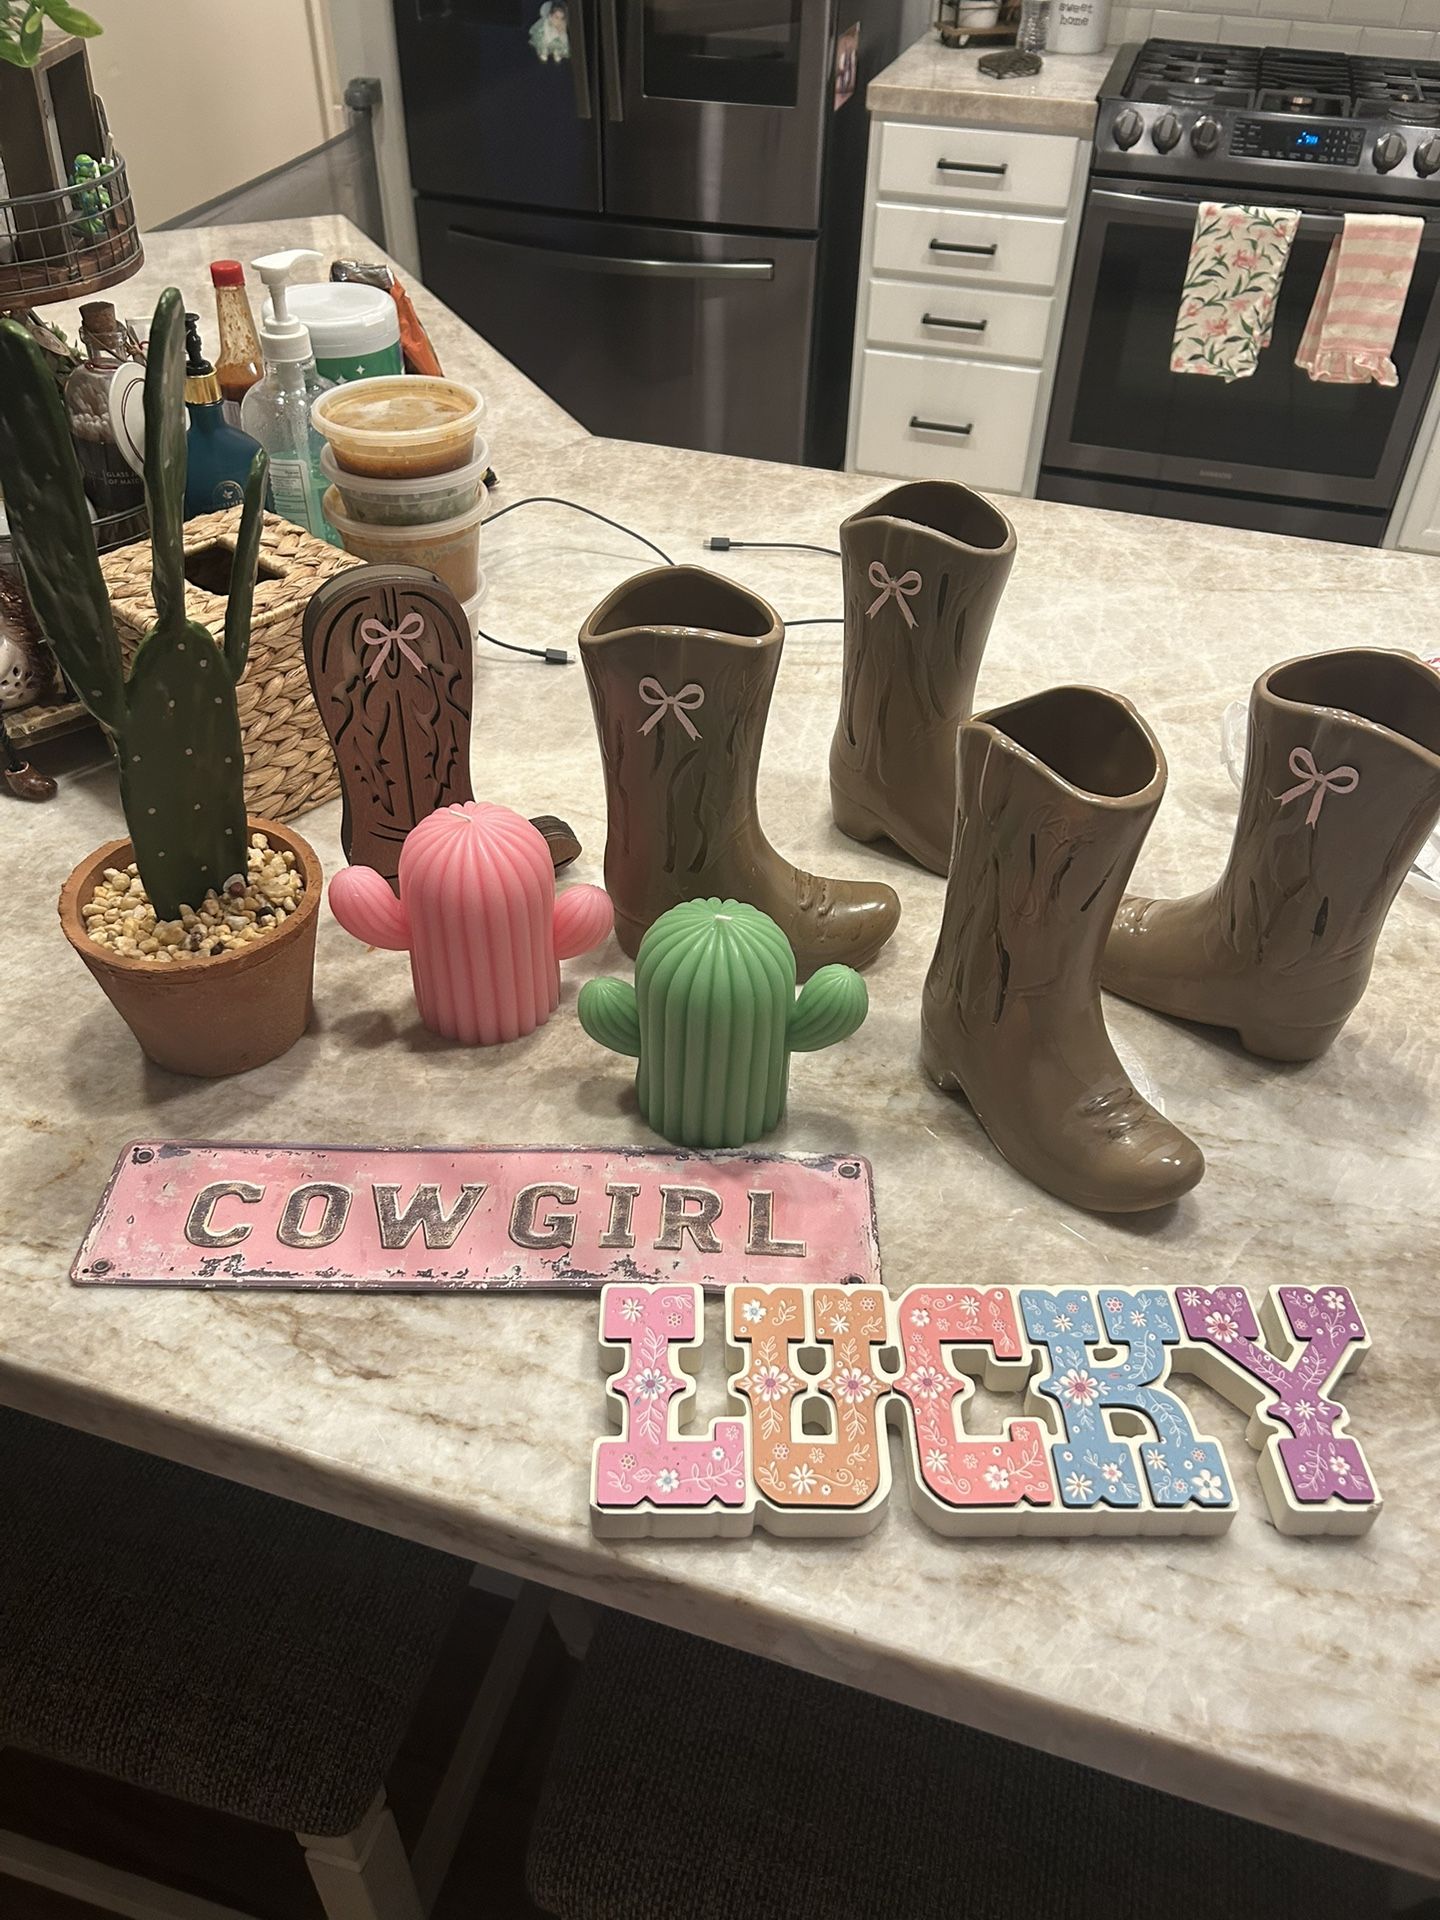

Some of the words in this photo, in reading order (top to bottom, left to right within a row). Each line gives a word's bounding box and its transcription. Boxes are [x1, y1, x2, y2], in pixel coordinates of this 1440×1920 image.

[1060, 14, 1089, 26] home
[182, 1178, 808, 1259] COWGIRL
[594, 1284, 1381, 1511] LUCKY
